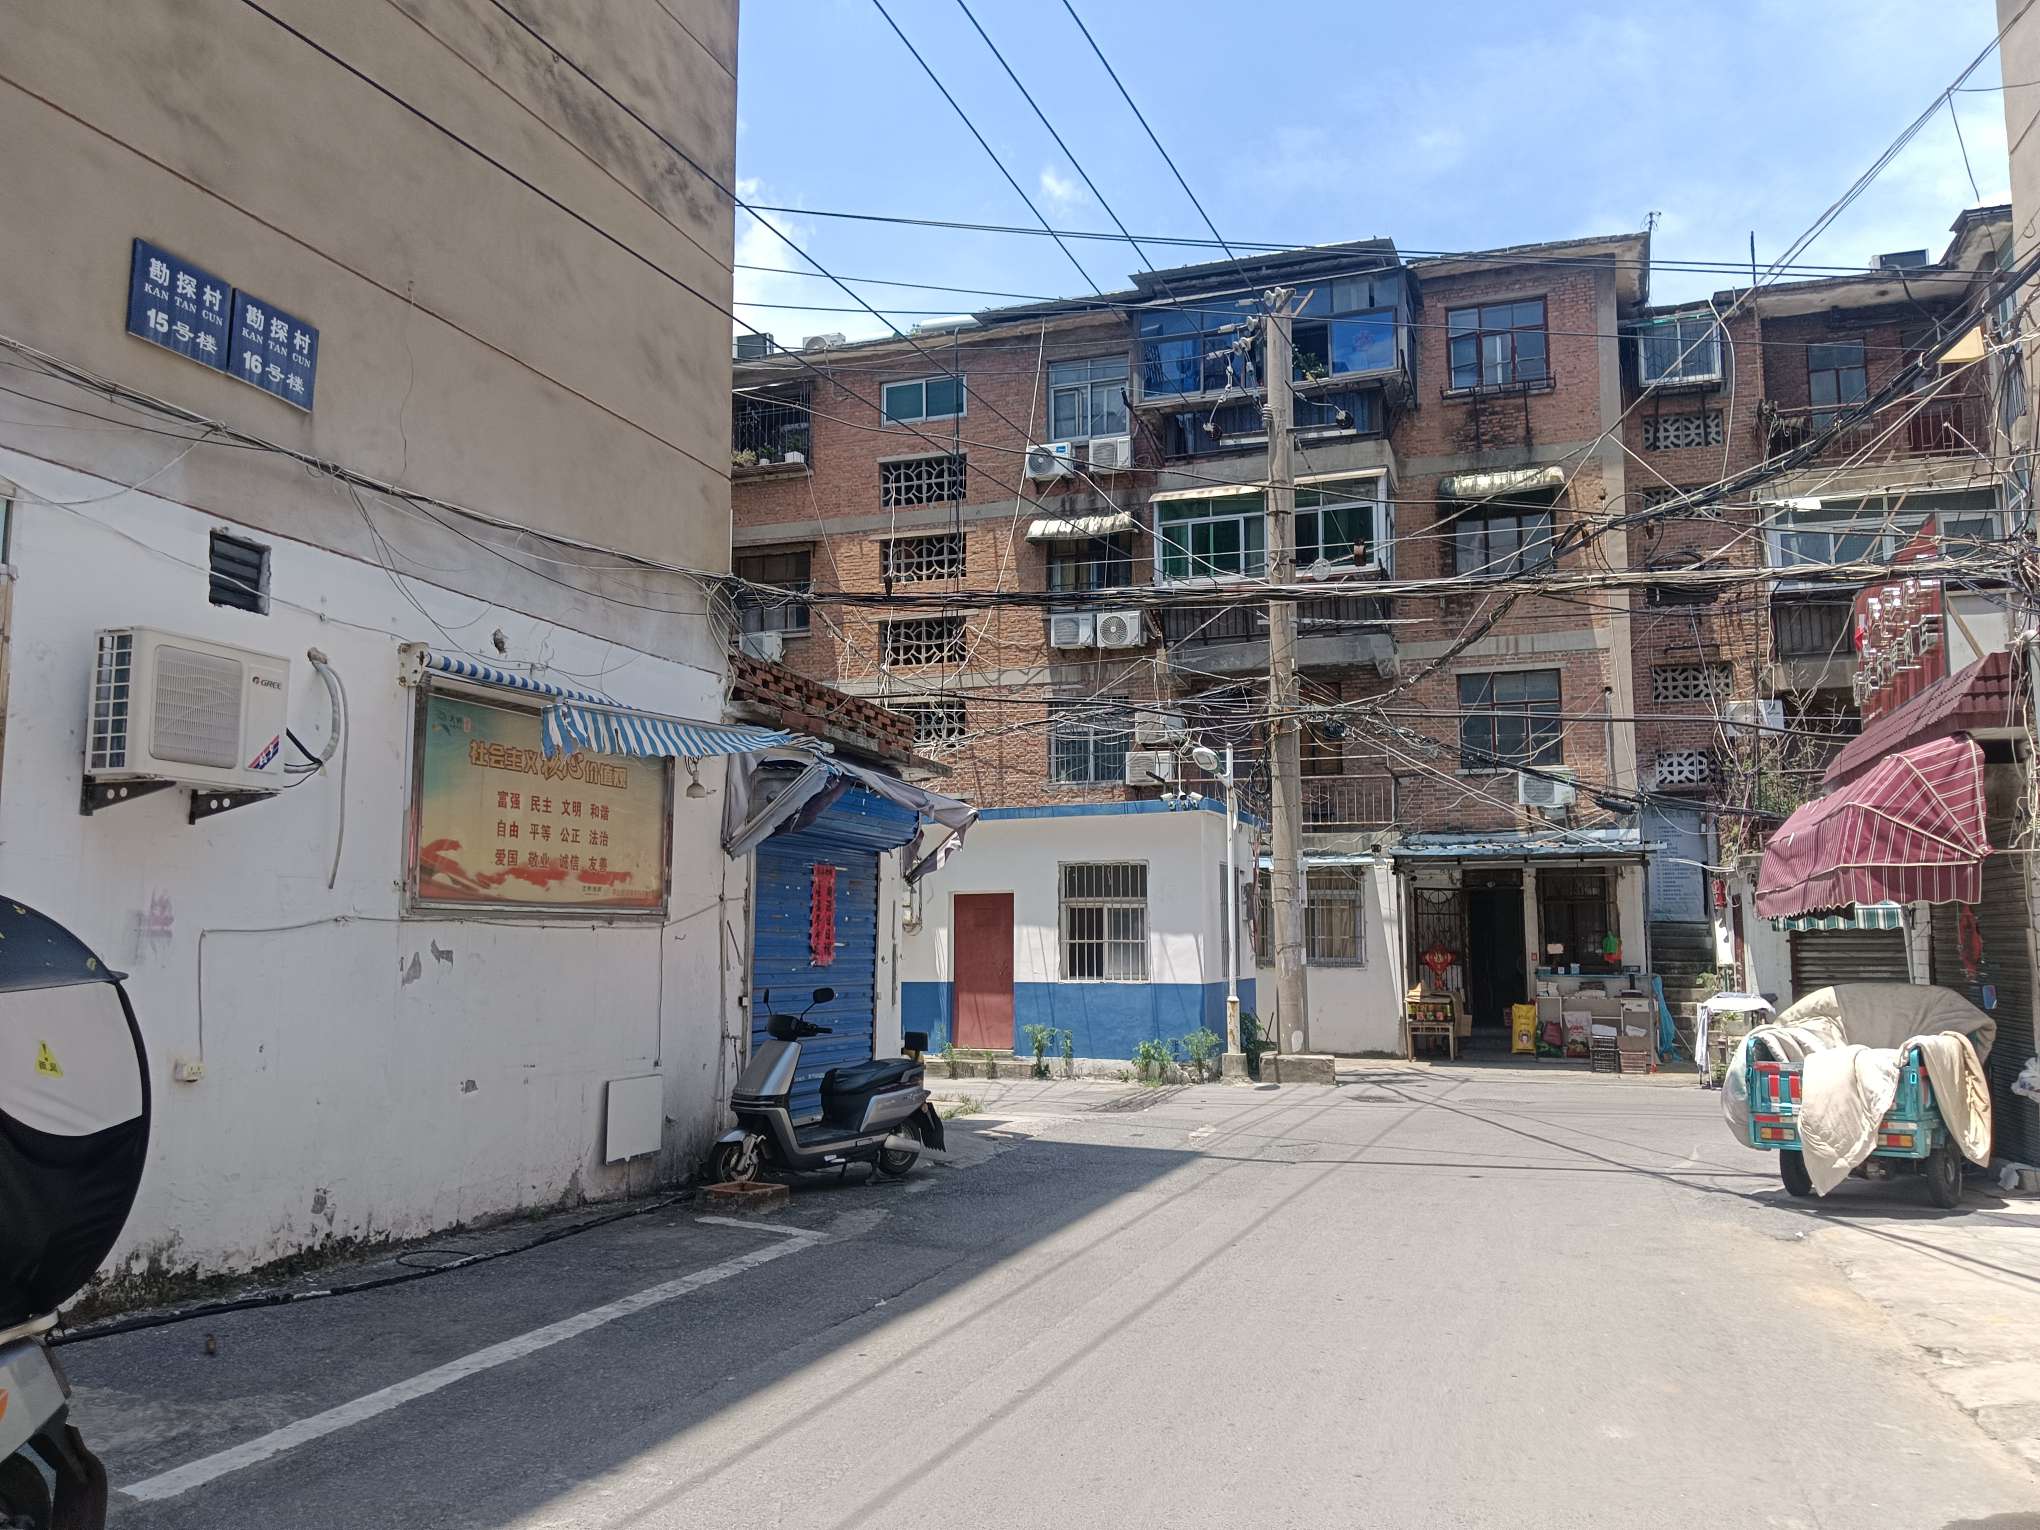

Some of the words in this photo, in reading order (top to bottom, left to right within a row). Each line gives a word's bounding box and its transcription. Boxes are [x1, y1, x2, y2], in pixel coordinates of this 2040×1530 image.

[144, 282, 169, 301] KAN
[174, 296, 197, 314] TAN
[202, 309, 223, 327] CUN
[148, 257, 223, 311] 勘探村
[146, 308, 218, 355] 15号楼
[241, 327, 264, 345] KAN
[267, 340, 288, 357] TAN
[292, 352, 311, 369] CUN
[246, 304, 311, 355] 勘探村
[243, 350, 305, 395] 16号楼
[497, 790, 520, 810] 富强
[530, 795, 552, 814] 民主
[561, 799, 582, 818] 文明
[590, 803, 609, 821] 和谐
[497, 819, 519, 839] 自由
[529, 823, 551, 842] 平等
[560, 827, 581, 844] 公正
[589, 830, 608, 847] 法治
[495, 848, 518, 866] 爱国
[528, 850, 550, 868] 敬业
[559, 853, 580, 872] 诚信
[588, 856, 608, 873] 友善
